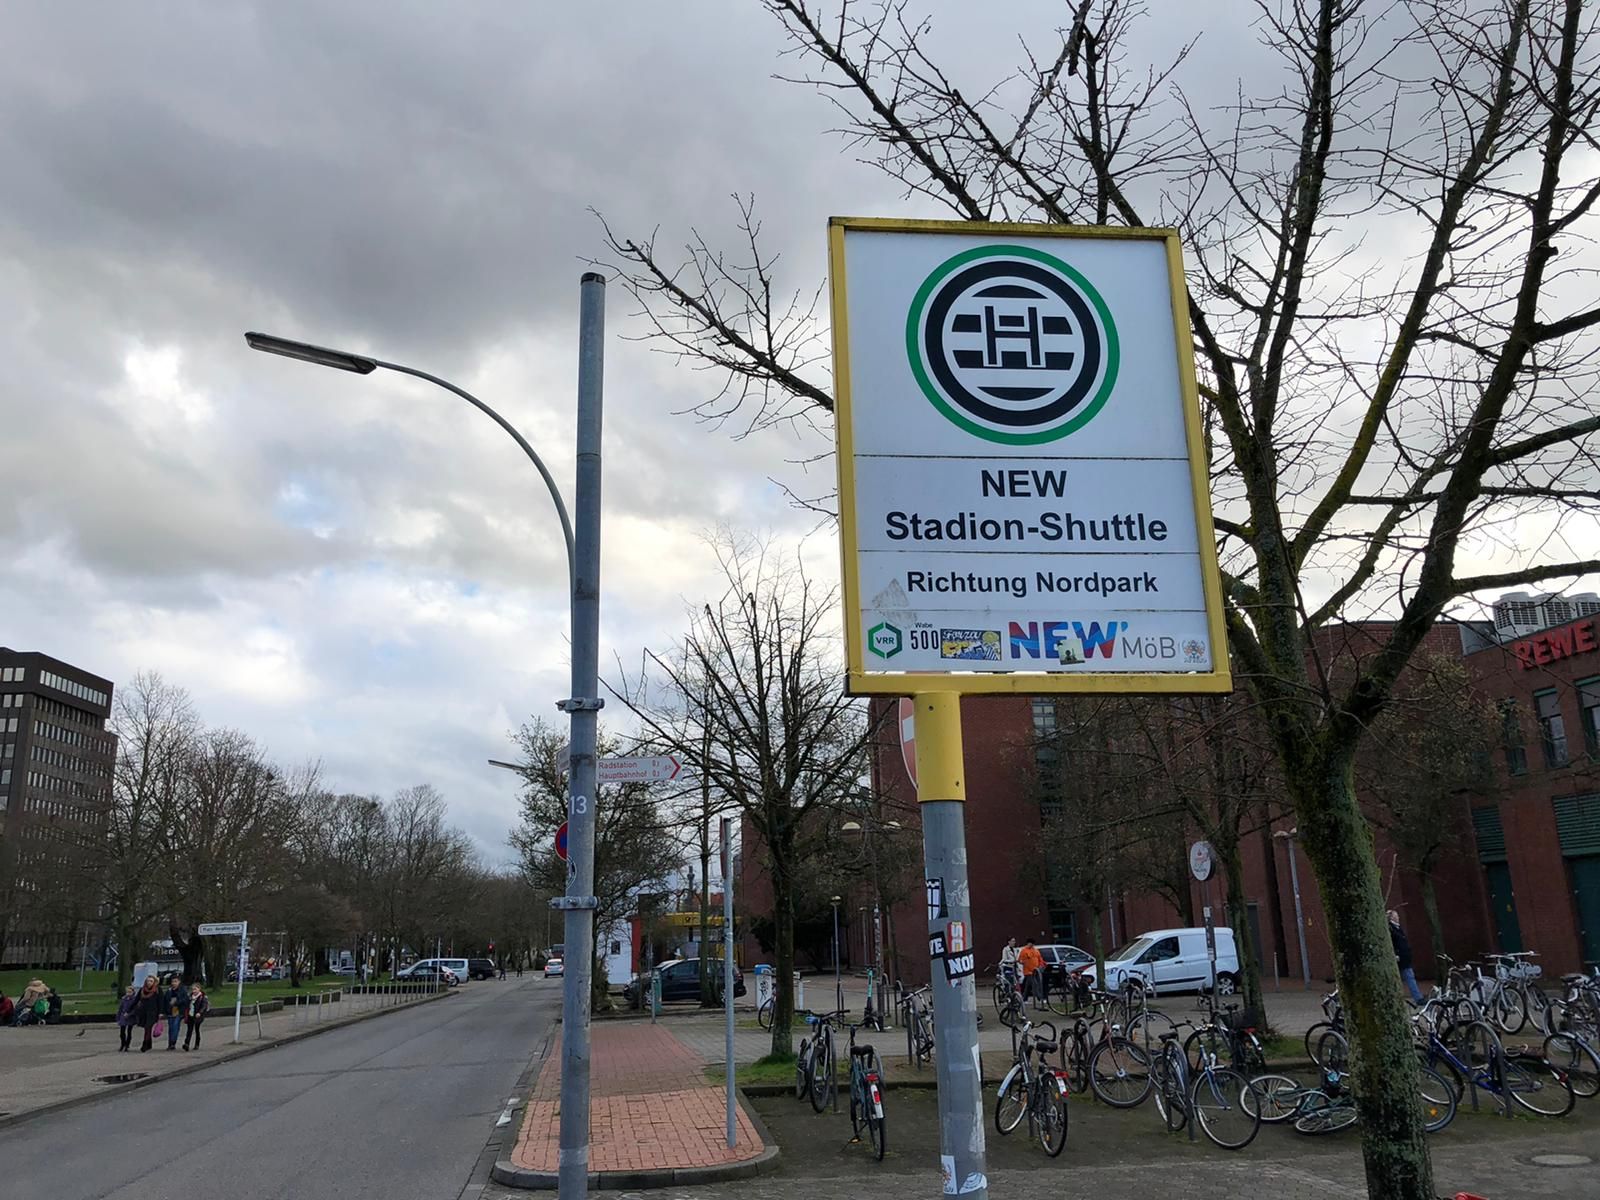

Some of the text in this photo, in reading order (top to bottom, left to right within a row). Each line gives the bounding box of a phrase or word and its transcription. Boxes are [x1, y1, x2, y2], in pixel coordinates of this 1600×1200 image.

[981, 470, 1067, 497] NEW
[886, 511, 1168, 541] Stadion-Shuttle
[907, 571, 1159, 597] Richtung Nordpark
[875, 636, 895, 645] VRR
[910, 630, 939, 650] 500
[1514, 620, 1594, 672] REWE
[598, 761, 638, 769] Radstation
[598, 770, 647, 779] Hauptbahnhof
[570, 795, 587, 815] 13
